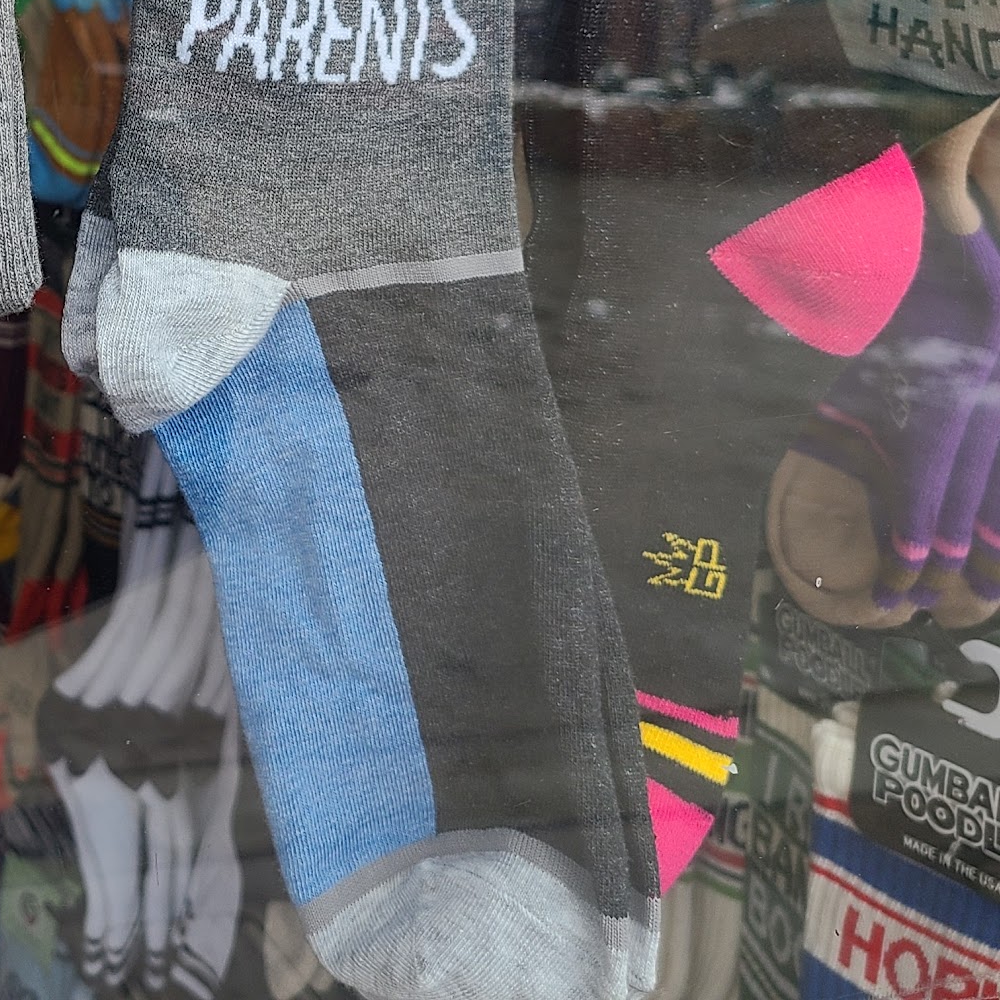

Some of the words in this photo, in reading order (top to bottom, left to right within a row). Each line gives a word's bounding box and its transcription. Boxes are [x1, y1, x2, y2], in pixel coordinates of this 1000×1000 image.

[870, 733, 1000, 822] GUMBA
[903, 834, 937, 863] MADE
[938, 850, 952, 869] IN
[954, 859, 979, 882] THE
